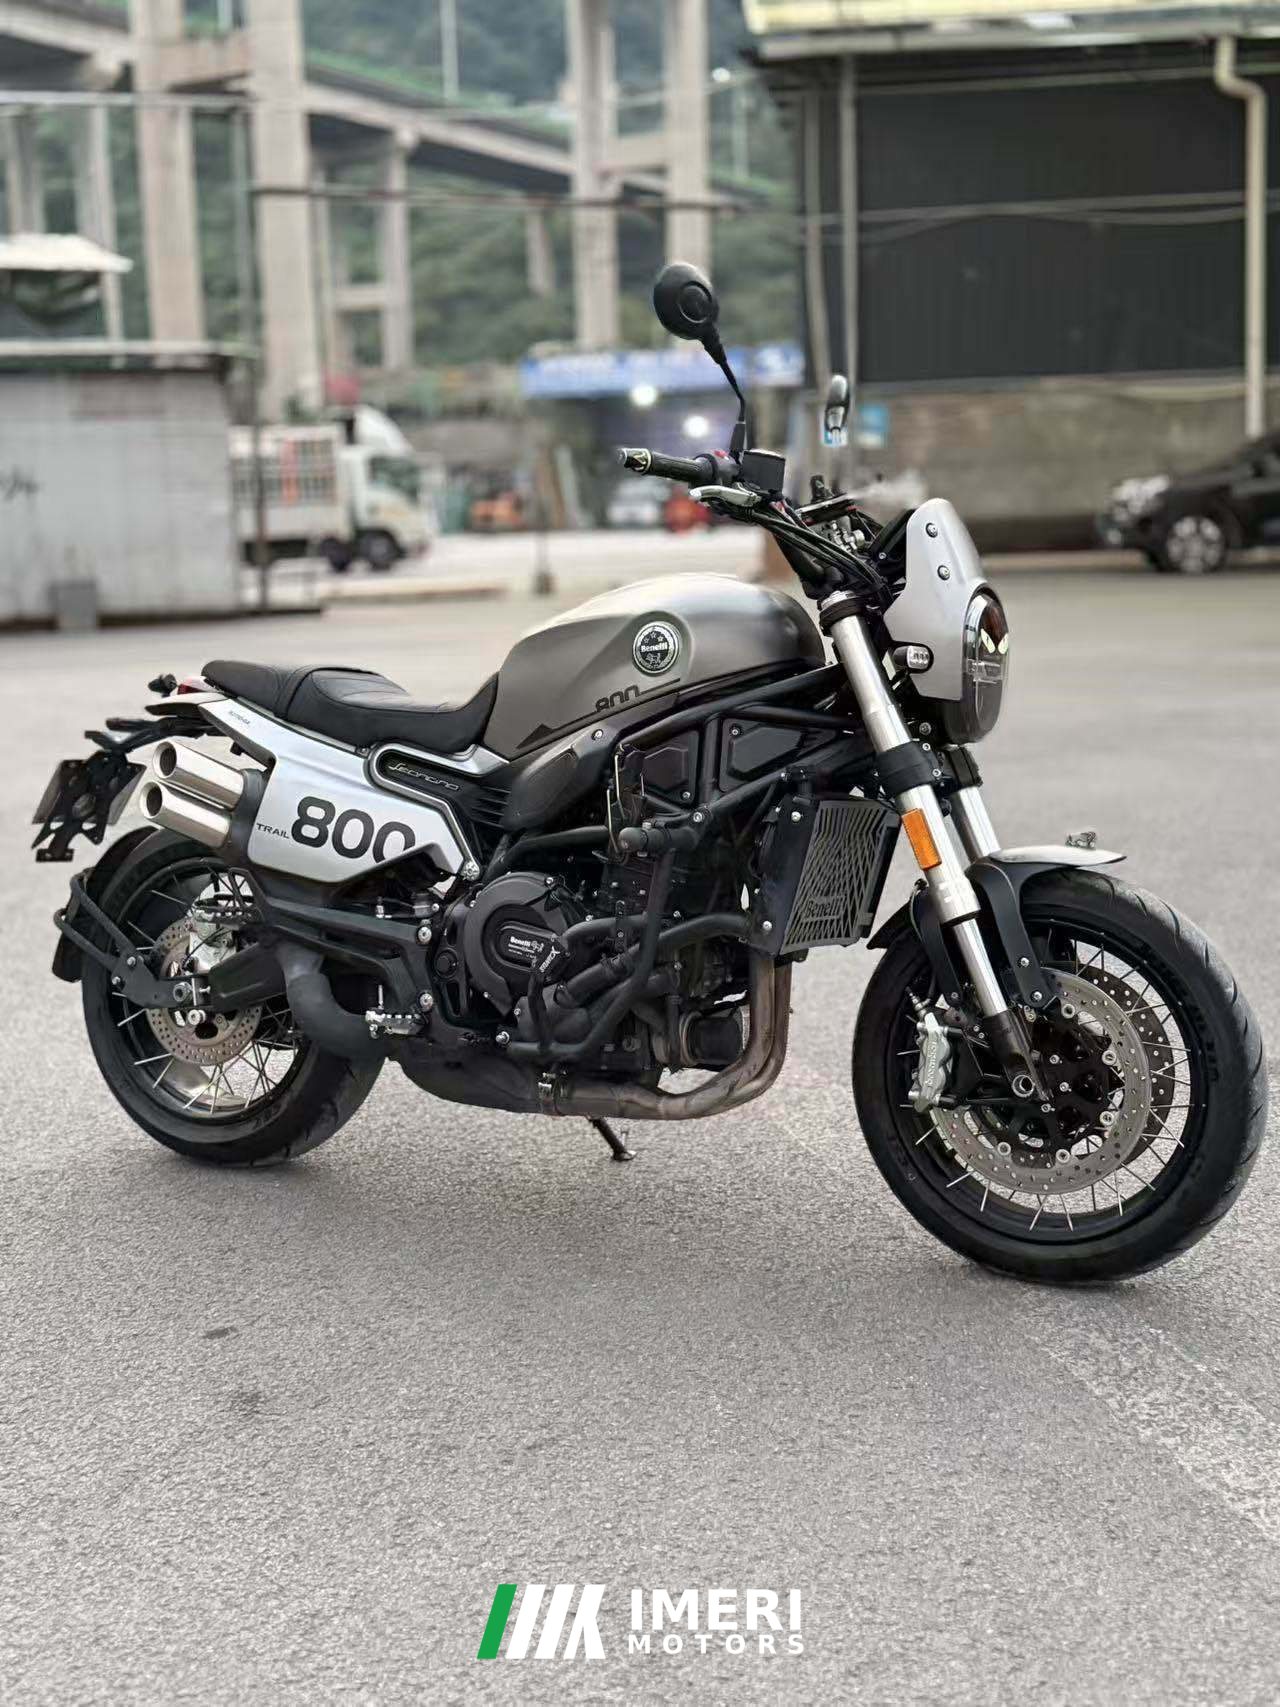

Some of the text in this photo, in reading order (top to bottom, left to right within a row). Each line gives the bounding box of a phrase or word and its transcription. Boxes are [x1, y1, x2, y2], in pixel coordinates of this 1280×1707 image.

[641, 642, 668, 652] Benelli
[256, 796, 416, 863] TRAIL 800
[806, 897, 842, 918] Benelli
